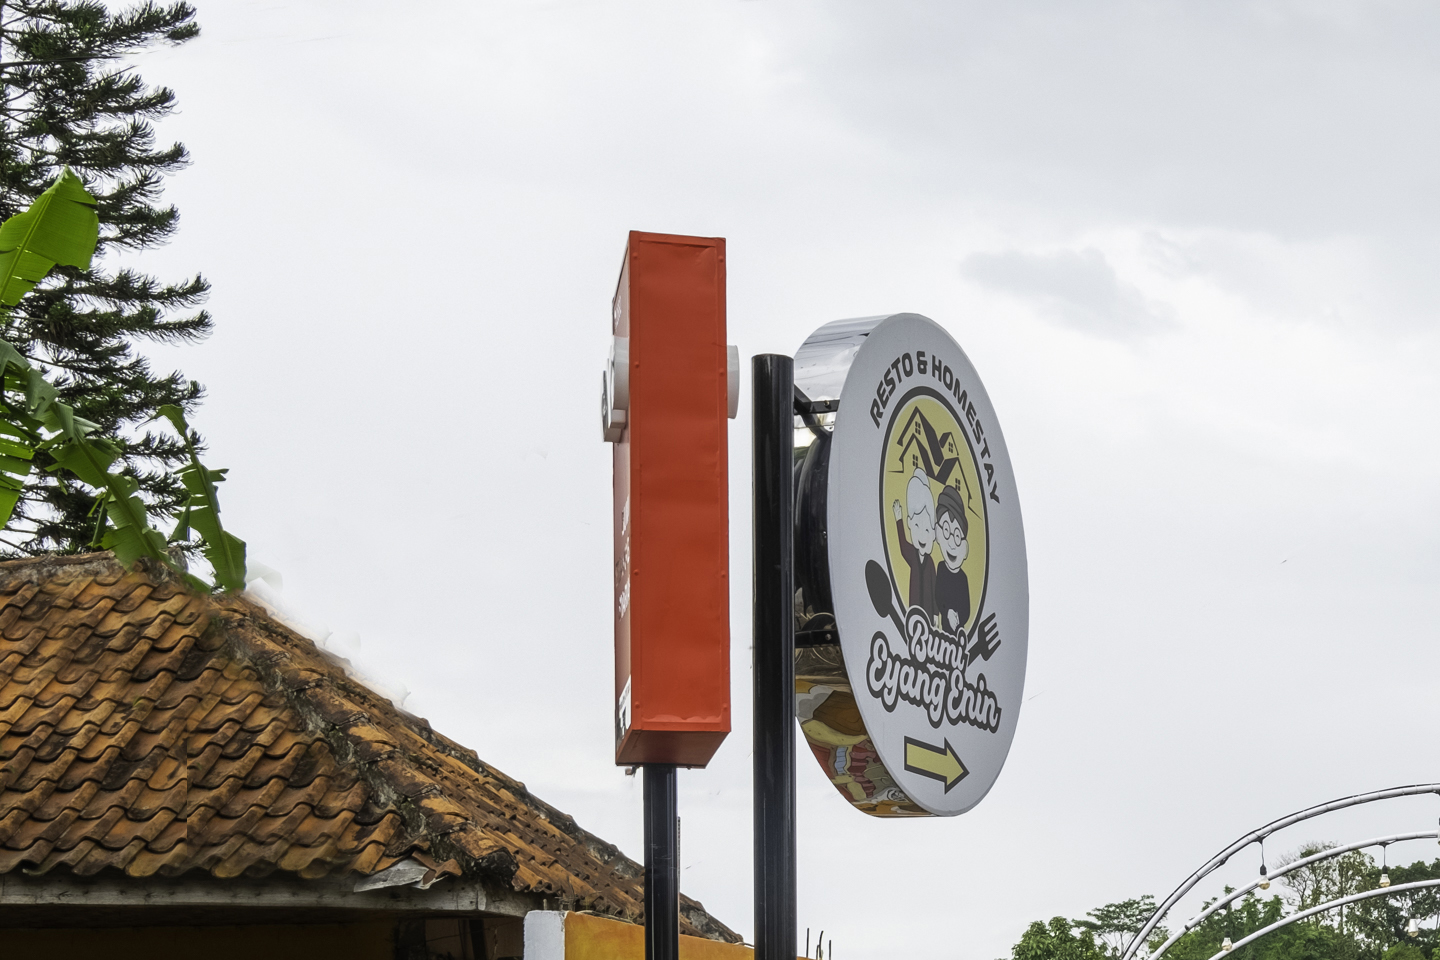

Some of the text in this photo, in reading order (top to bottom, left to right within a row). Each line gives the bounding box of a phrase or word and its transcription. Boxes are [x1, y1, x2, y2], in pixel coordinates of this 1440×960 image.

[870, 350, 1000, 504] RESTO & HOMESTAY
[868, 638, 999, 728] Eyang Enin
[907, 614, 965, 670] Bumi
